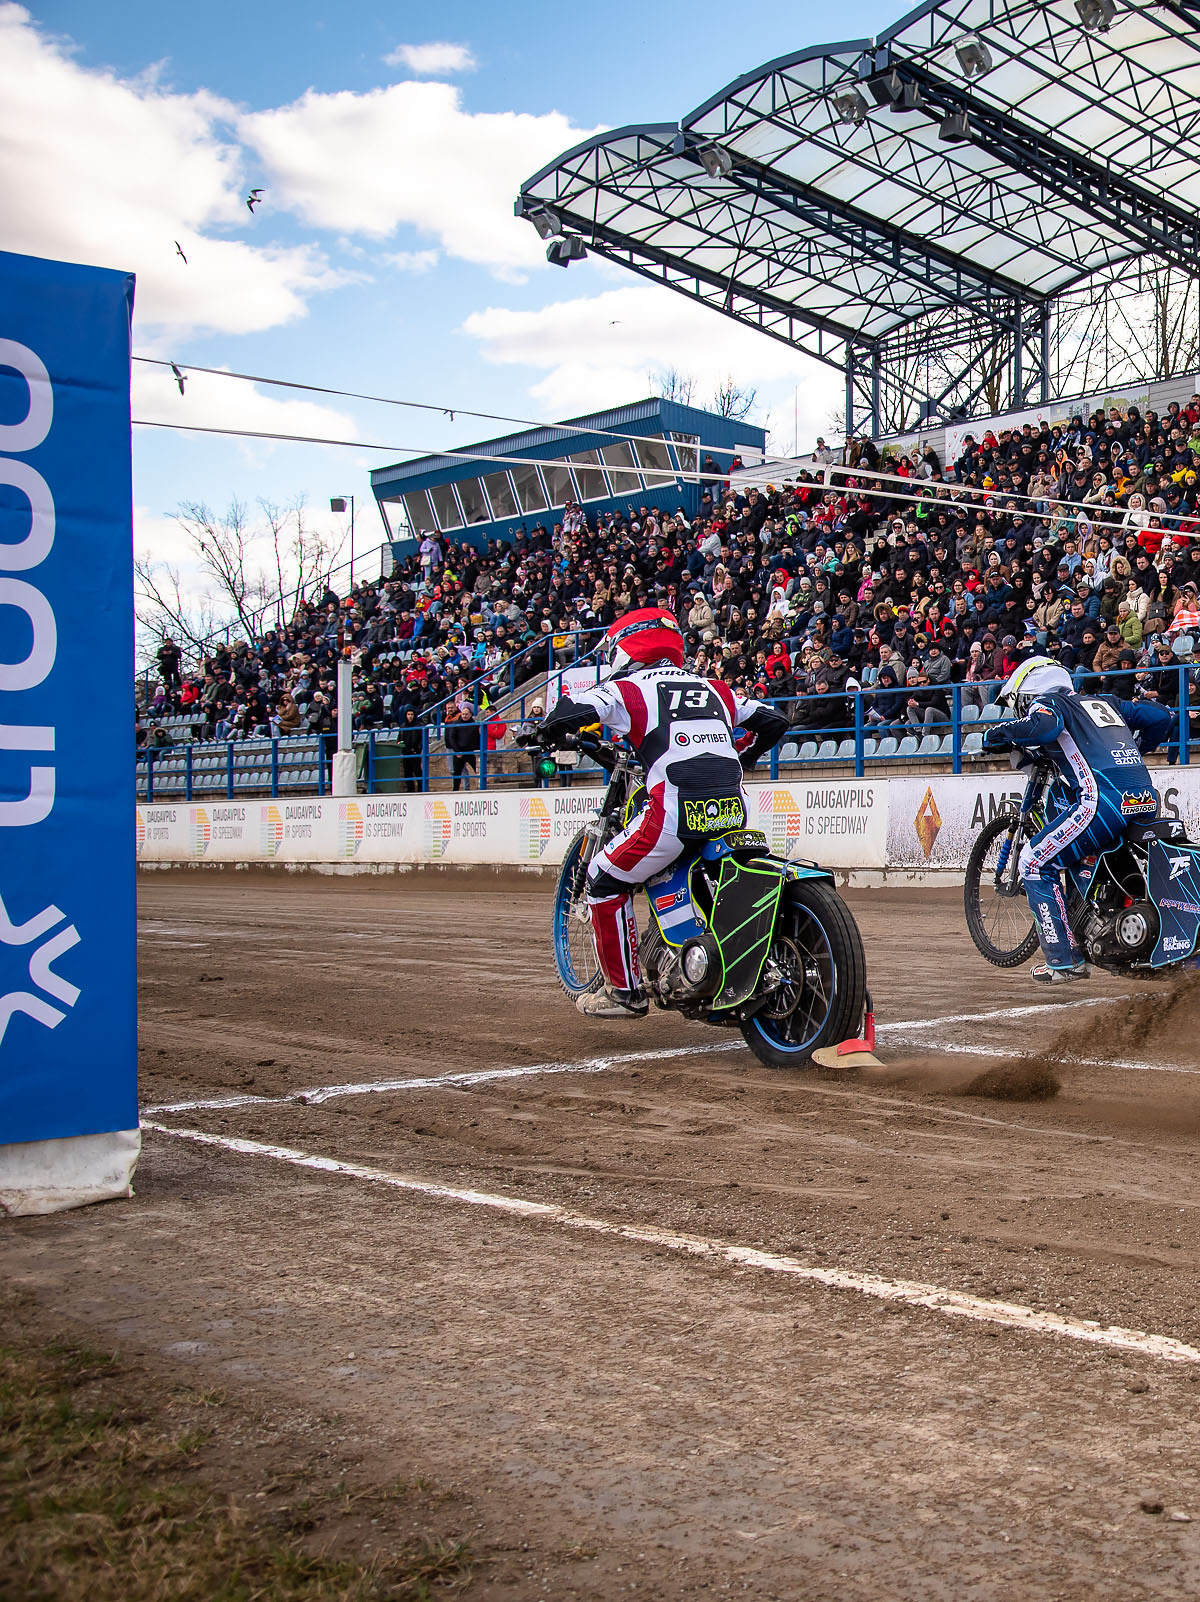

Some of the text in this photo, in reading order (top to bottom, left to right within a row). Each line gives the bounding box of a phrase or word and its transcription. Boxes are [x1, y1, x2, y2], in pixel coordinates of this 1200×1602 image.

[668, 689, 710, 711] 13
[1091, 702, 1116, 725] 3
[692, 733, 728, 744] OPTIBET
[806, 789, 874, 809] DAUGAVPILS
[147, 810, 177, 823] DAUGAVPILS
[212, 808, 246, 822] DAUGAVPILS
[285, 805, 322, 820] DAUGAVPILS
[367, 802, 407, 818] DAUGAVPILS
[454, 800, 499, 817] DAUGAVPILS
[970, 792, 1023, 829] AMB
[554, 821, 561, 837] IS
[706, 813, 744, 829] RACING
[805, 815, 869, 835] IS SPEEDWAY
[212, 826, 243, 839] IS SPEEDWAY
[285, 824, 312, 839] IR SPORTS
[365, 823, 404, 838] IS SPEEDWAY
[454, 822, 487, 838] IR SPORTS
[1163, 940, 1191, 952] RACING
